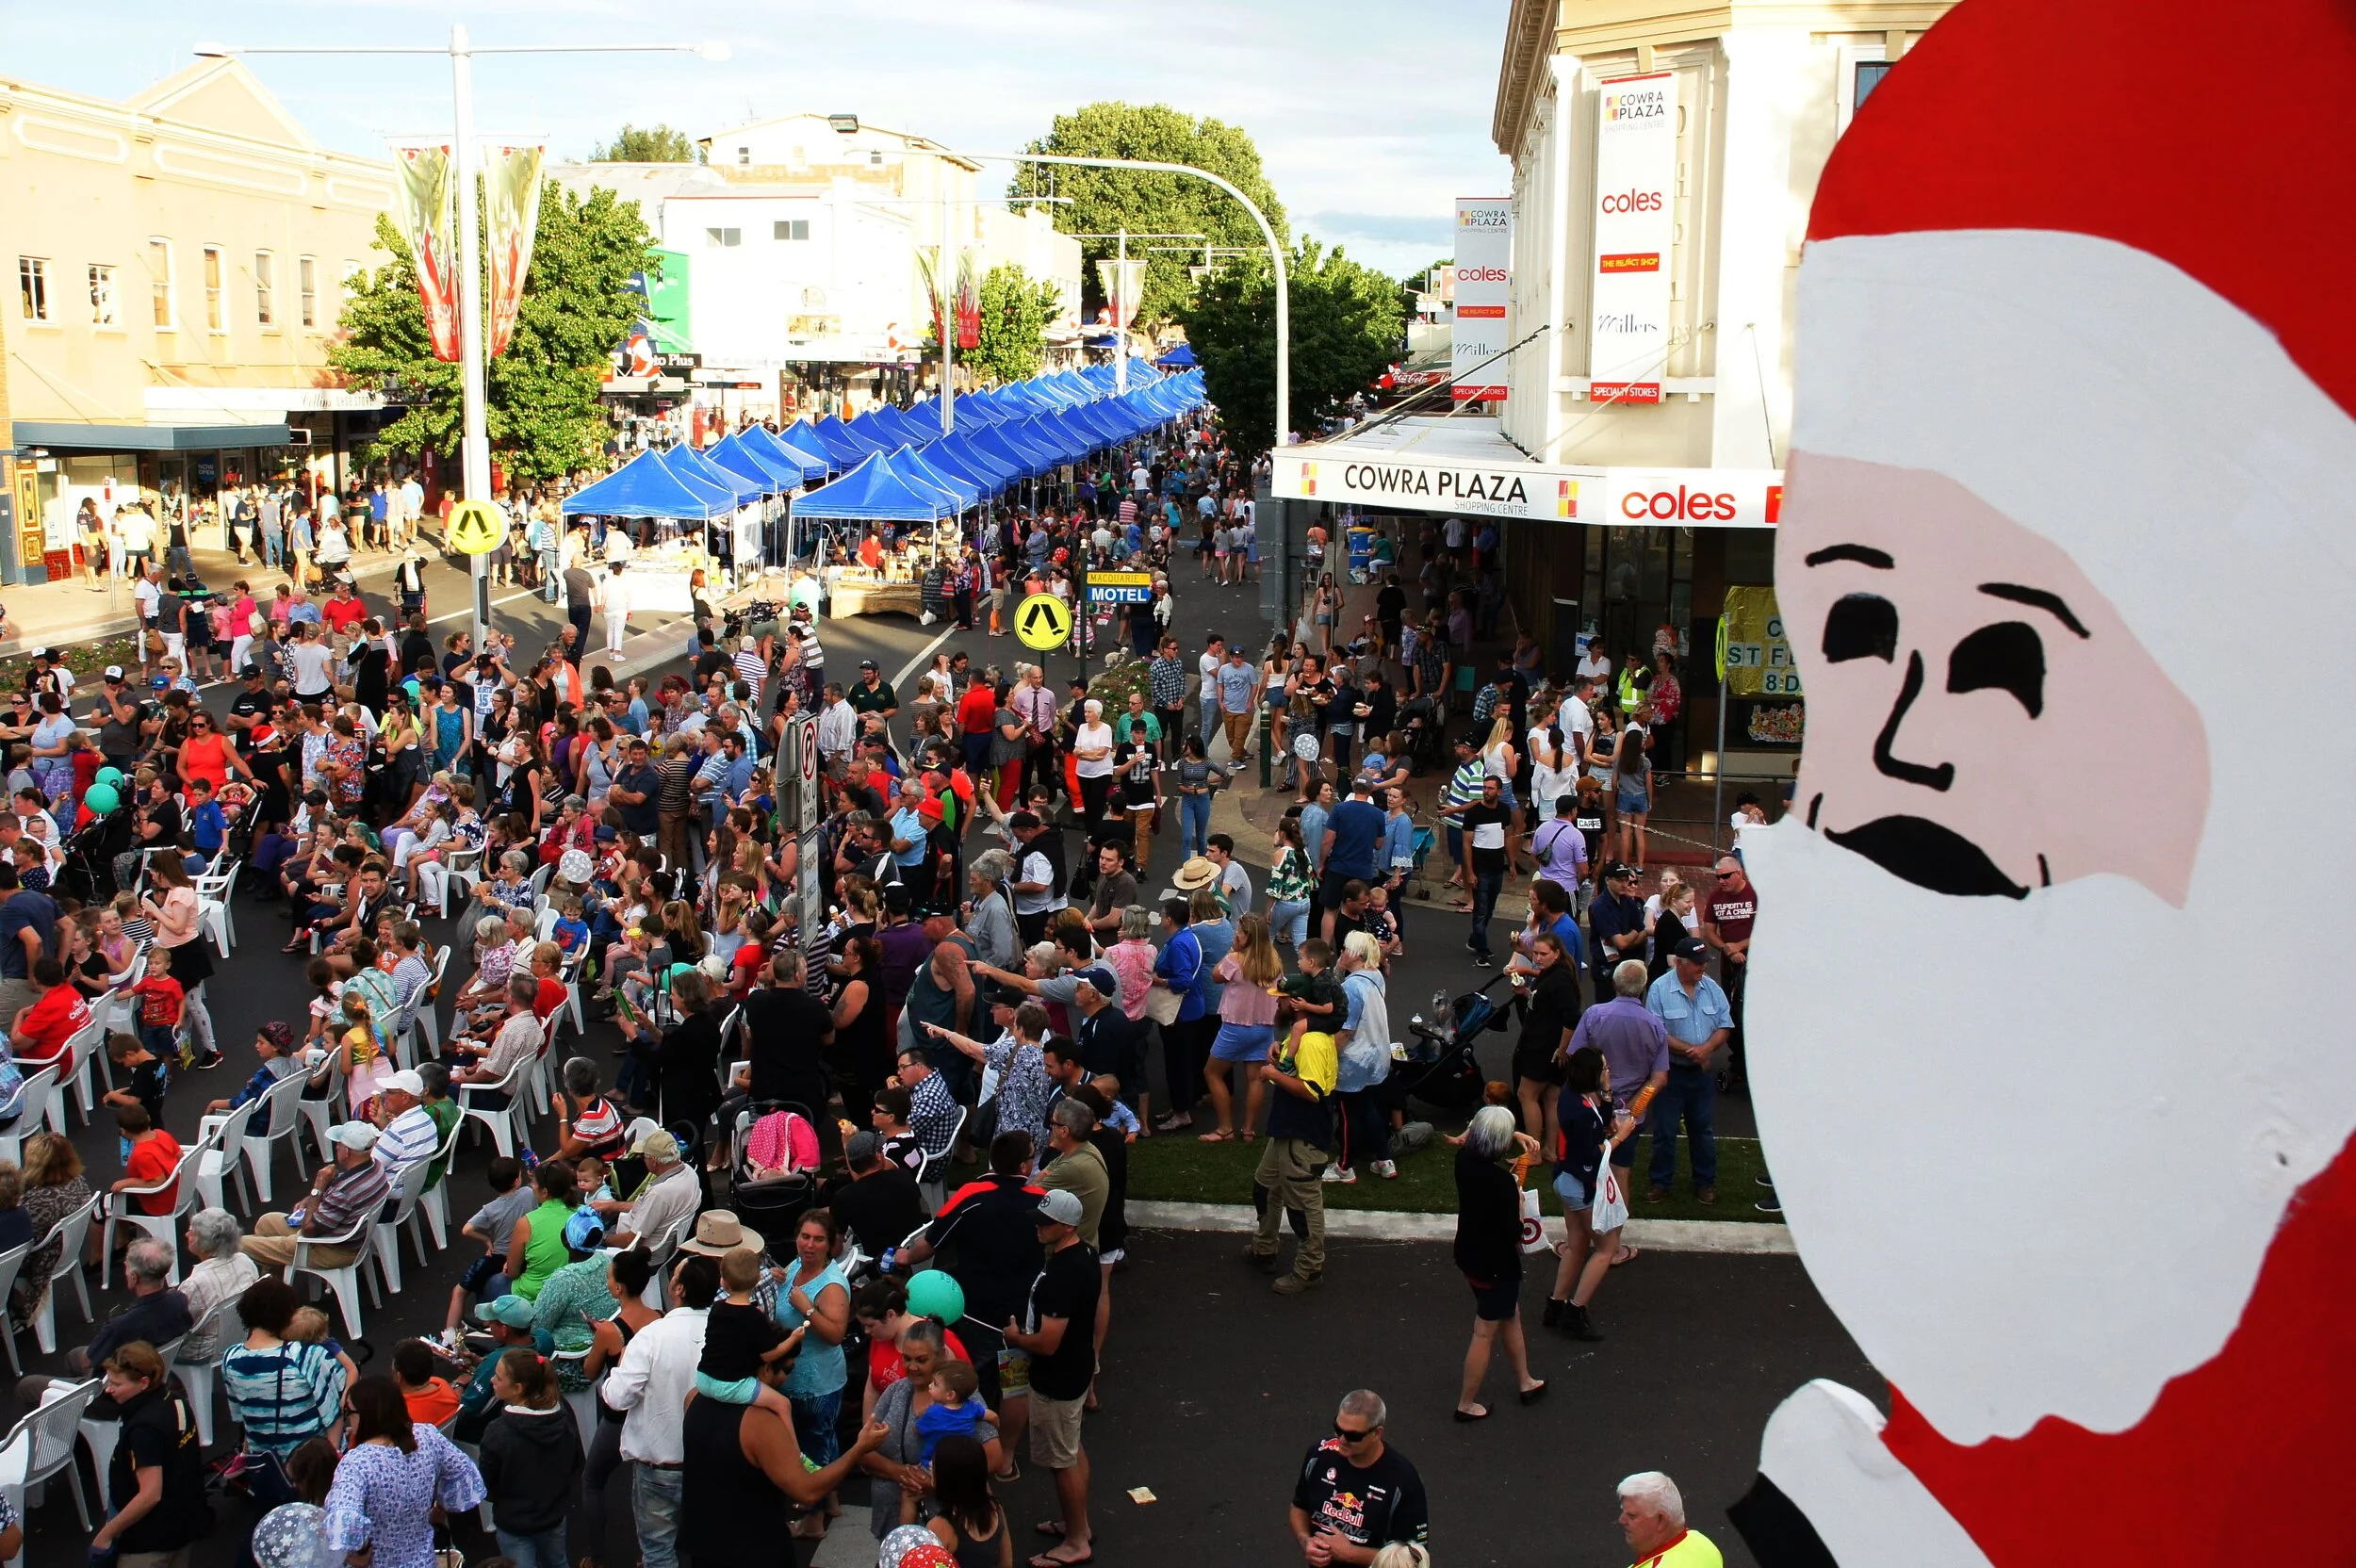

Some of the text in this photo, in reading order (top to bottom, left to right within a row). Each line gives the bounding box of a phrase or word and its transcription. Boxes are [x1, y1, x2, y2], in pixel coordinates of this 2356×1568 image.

[1620, 91, 1663, 106] COWRA
[1620, 104, 1664, 120] PLAZA
[1605, 119, 1665, 133] SHOPPING CENTRE
[1602, 188, 1661, 214] coles
[1470, 218, 1507, 226] PLAZA
[1641, 257, 1658, 266] SHOP
[1458, 265, 1507, 282] coles
[1598, 314, 1658, 333] Millers
[668, 353, 695, 367] Plus
[1630, 387, 1658, 397] STORES
[1345, 465, 1528, 503] COWRA PLAZA
[1454, 499, 1529, 516] SHOPPING CENTRE
[1621, 484, 1736, 520] coles
[1091, 574, 1138, 582] MACQUARIE
[1091, 588, 1147, 601] MOTEL
[803, 804, 816, 828] TURN
[1713, 902, 1743, 910] STUPIDITY
[1312, 1511, 1372, 1539] RACING
